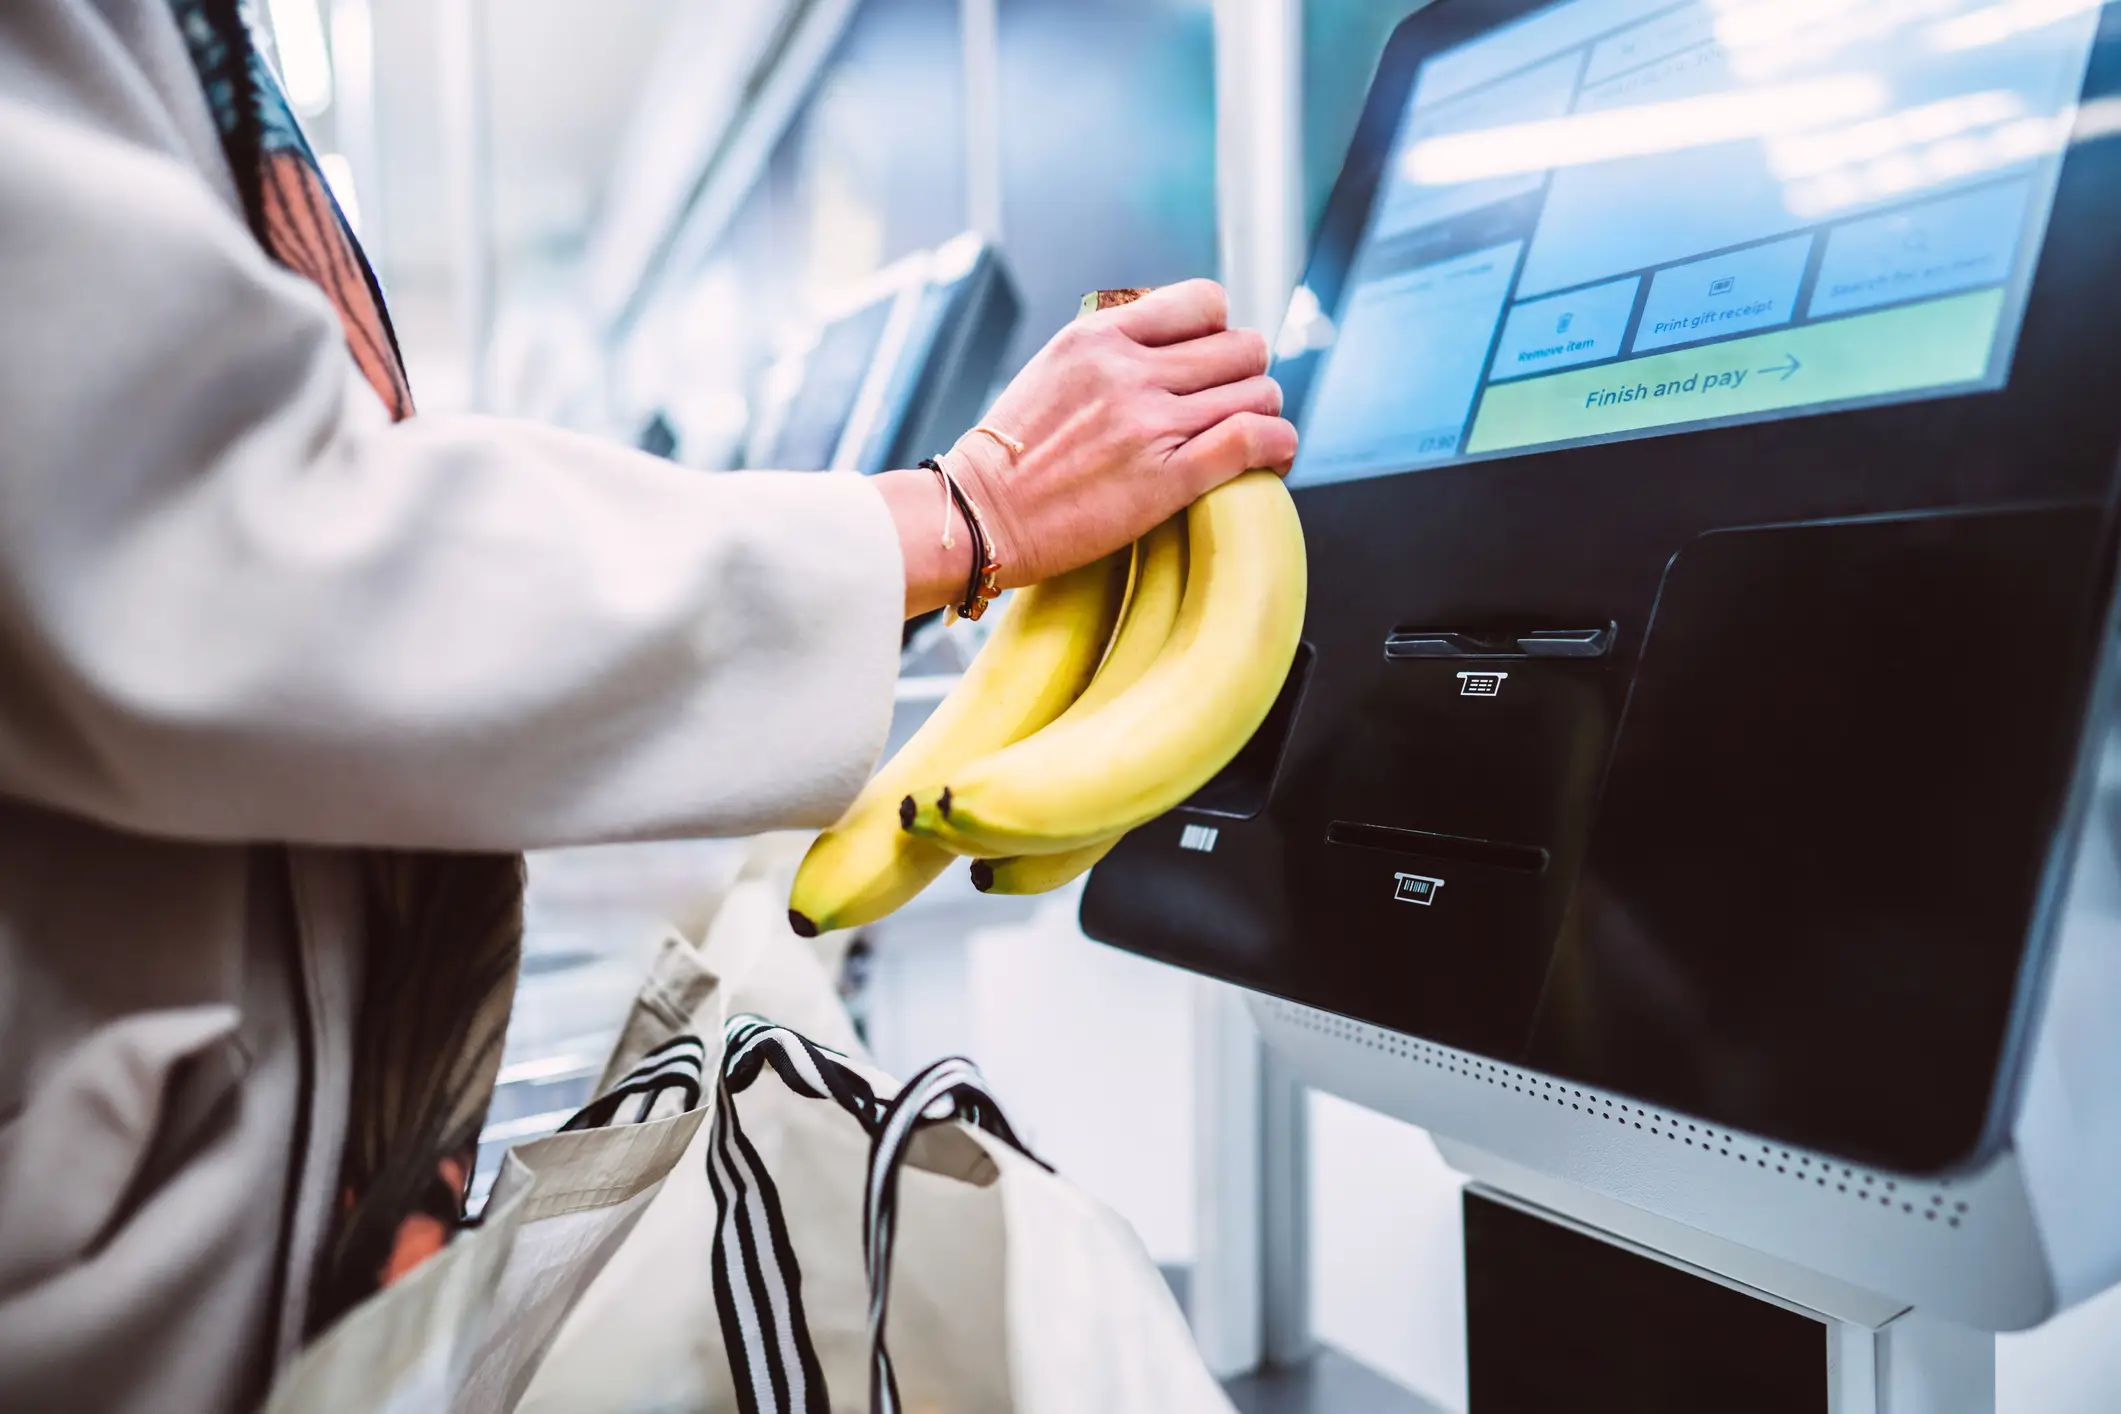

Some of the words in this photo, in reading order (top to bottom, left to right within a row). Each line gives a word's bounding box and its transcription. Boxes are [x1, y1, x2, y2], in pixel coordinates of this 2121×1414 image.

[1831, 275, 1888, 297] Search
[1654, 318, 1688, 334] Print
[1691, 311, 1716, 329] gift
[1719, 300, 1773, 317] receipt
[1518, 346, 1564, 362] Remove
[1566, 338, 1594, 351] item
[1585, 383, 1647, 408] Finish
[1653, 373, 1698, 397] and
[1701, 368, 1748, 393] pay
